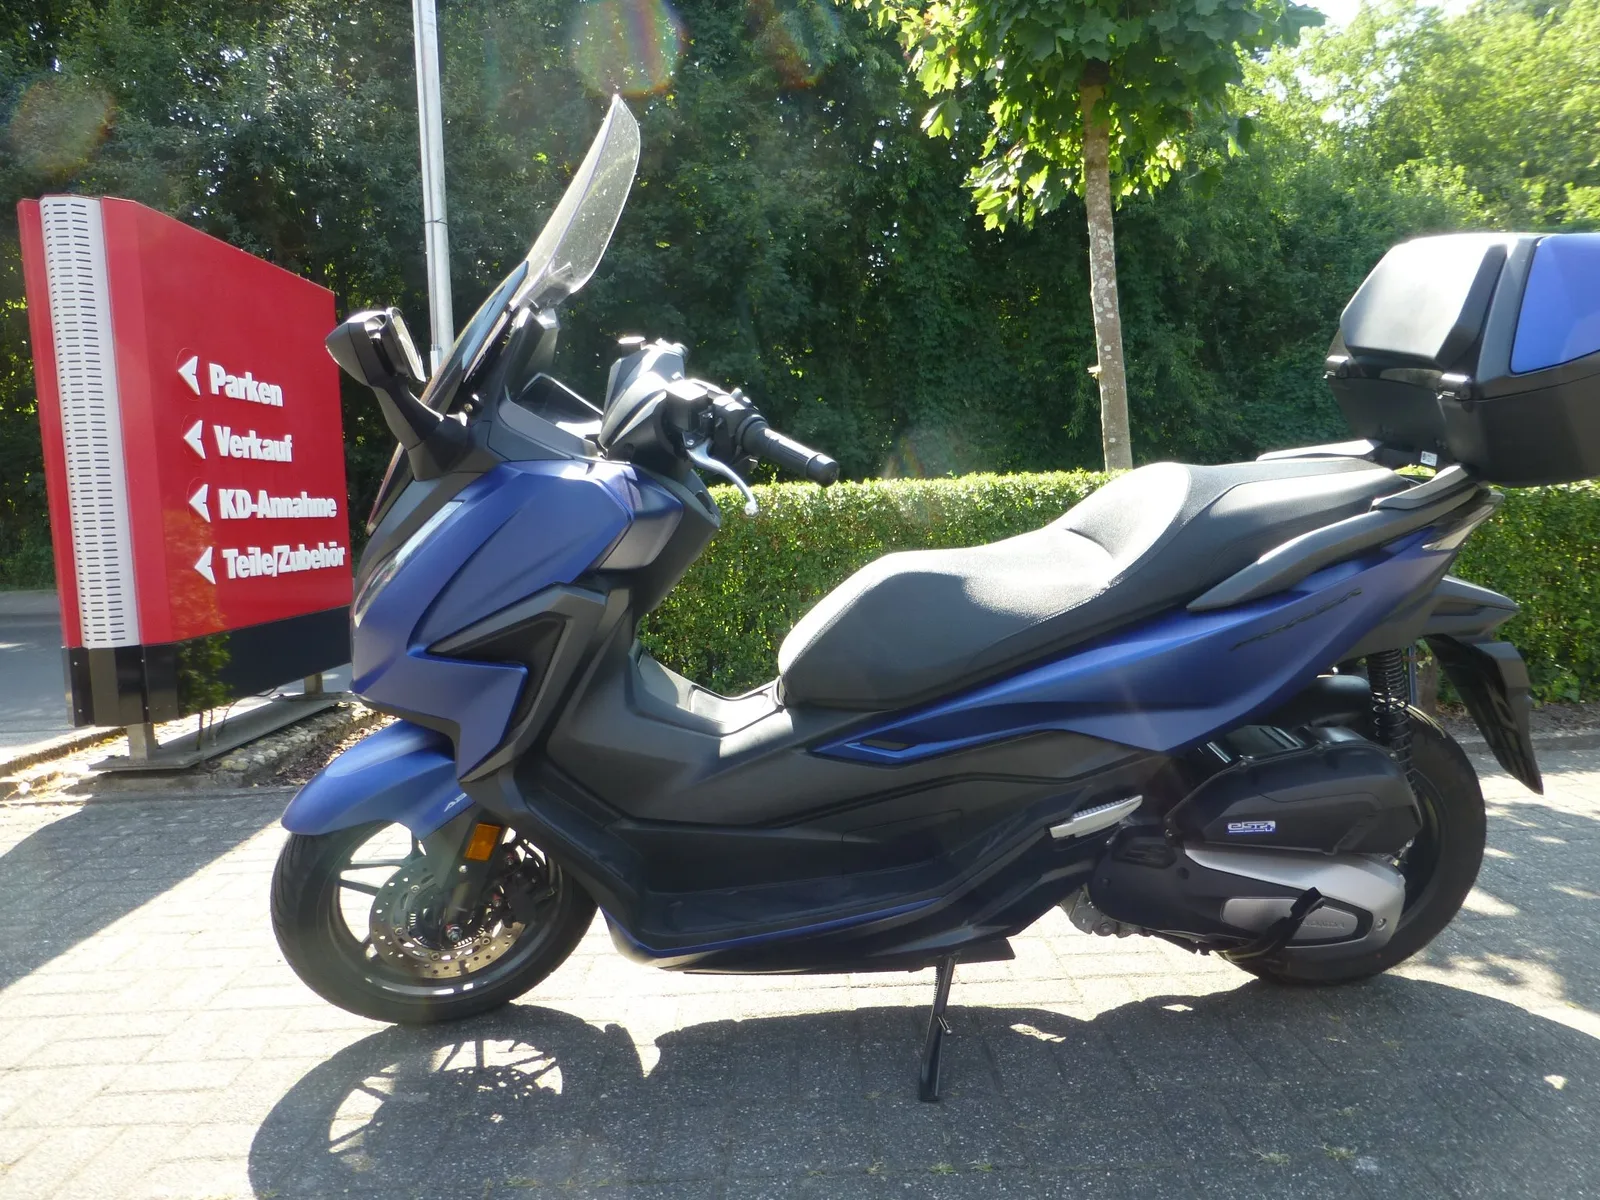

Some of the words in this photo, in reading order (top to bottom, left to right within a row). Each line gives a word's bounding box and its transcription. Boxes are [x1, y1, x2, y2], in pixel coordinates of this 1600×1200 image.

[209, 363, 283, 406] Parken
[214, 425, 292, 462] Verkauf
[218, 489, 337, 519] KD-Annahme
[222, 542, 345, 579] Teile/Zubehör
